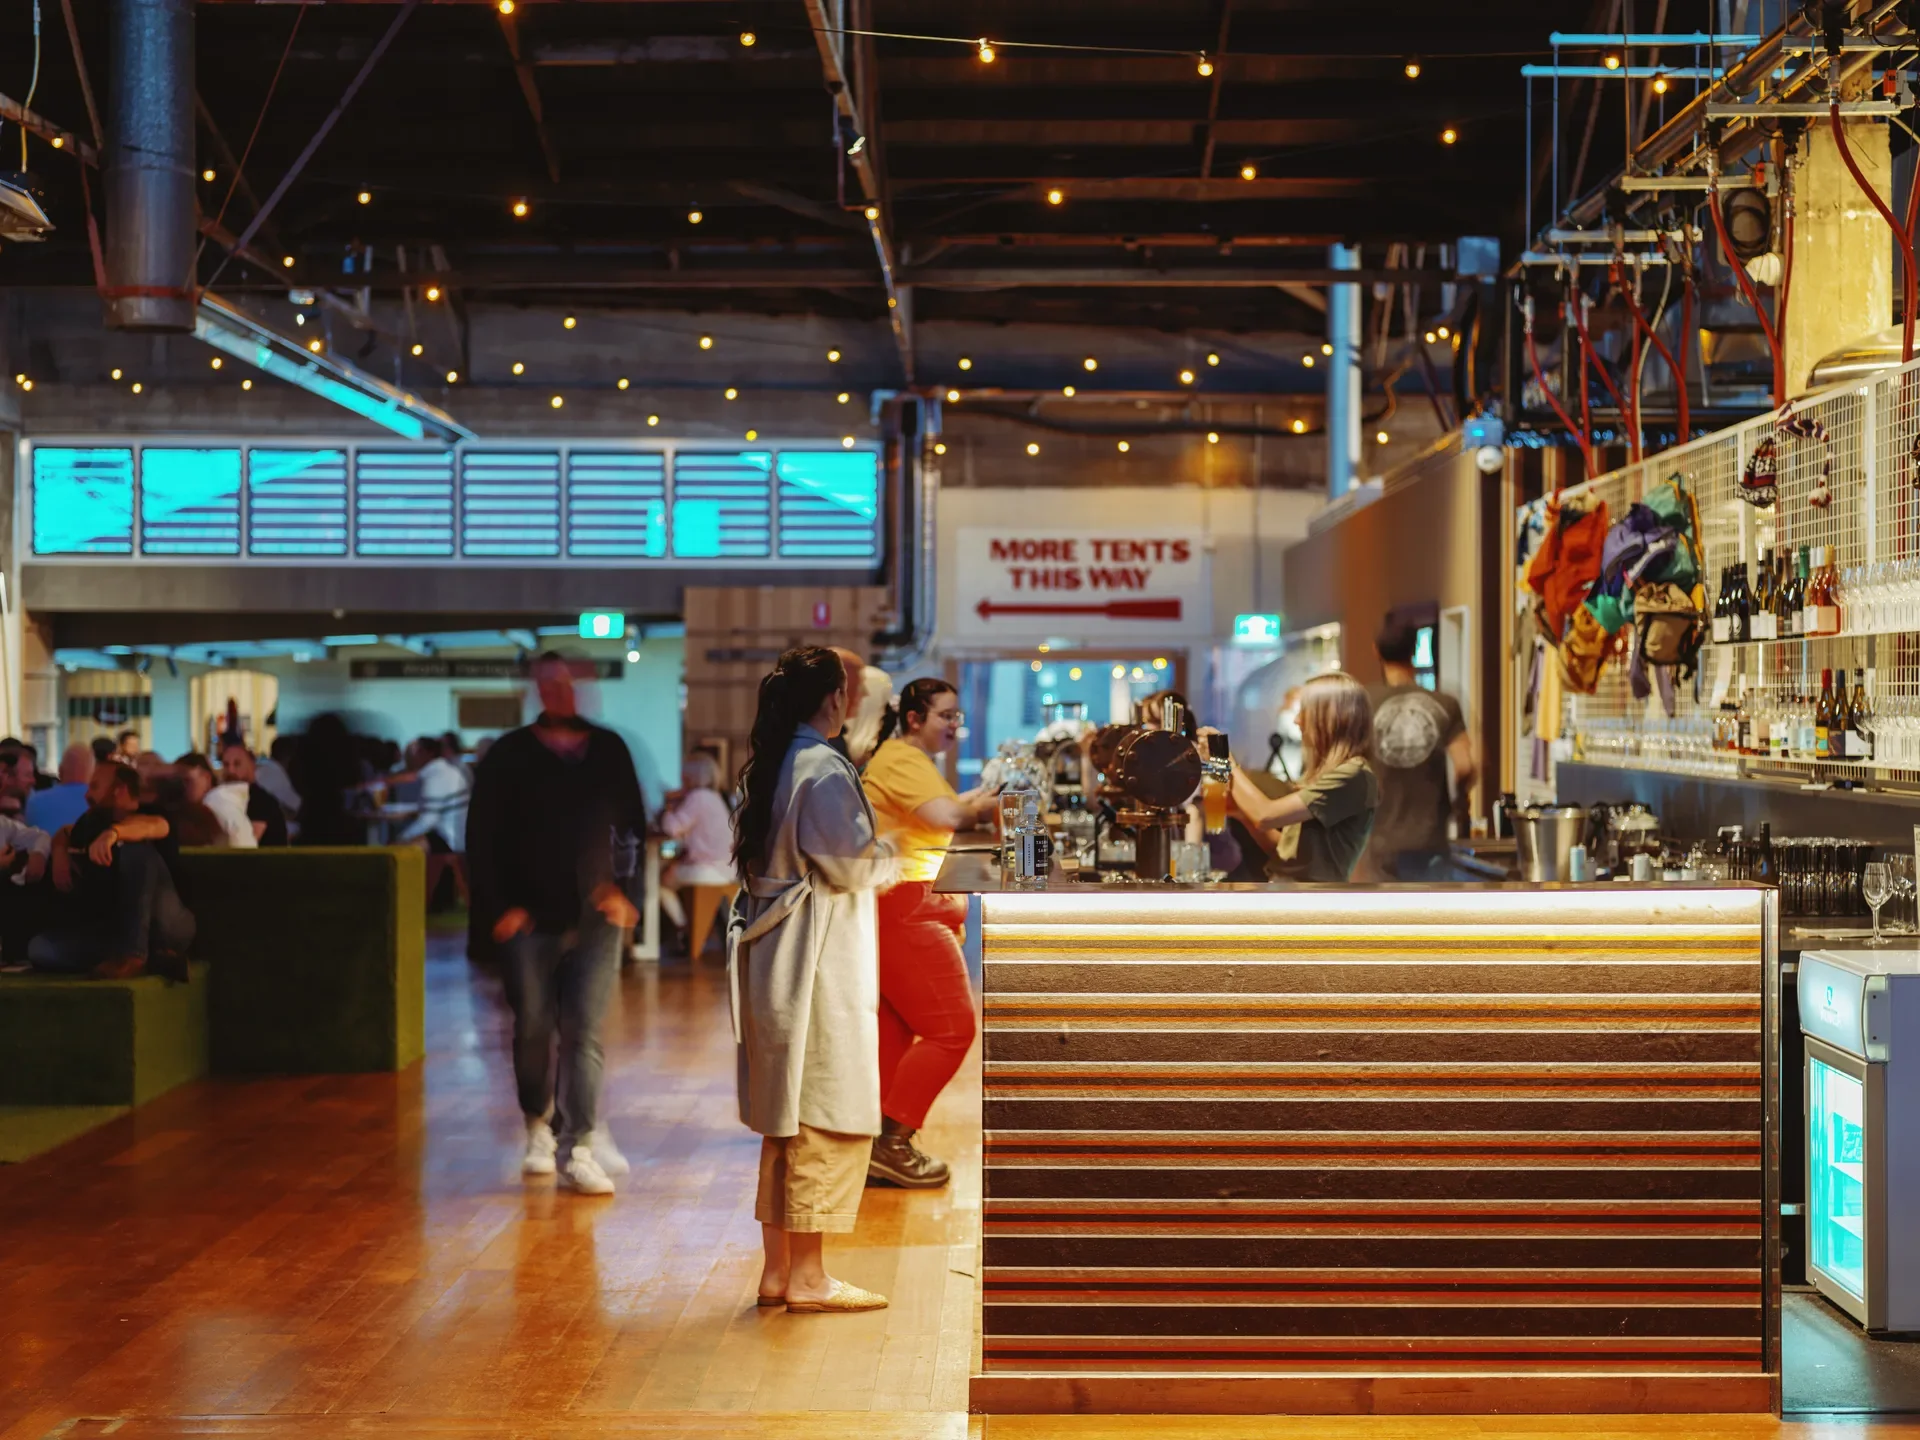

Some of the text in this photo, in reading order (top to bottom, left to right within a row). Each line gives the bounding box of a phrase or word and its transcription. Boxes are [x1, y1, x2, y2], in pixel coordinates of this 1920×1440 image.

[989, 538, 1191, 563] MORE TENTS
[1008, 567, 1152, 591] THIS WAY
